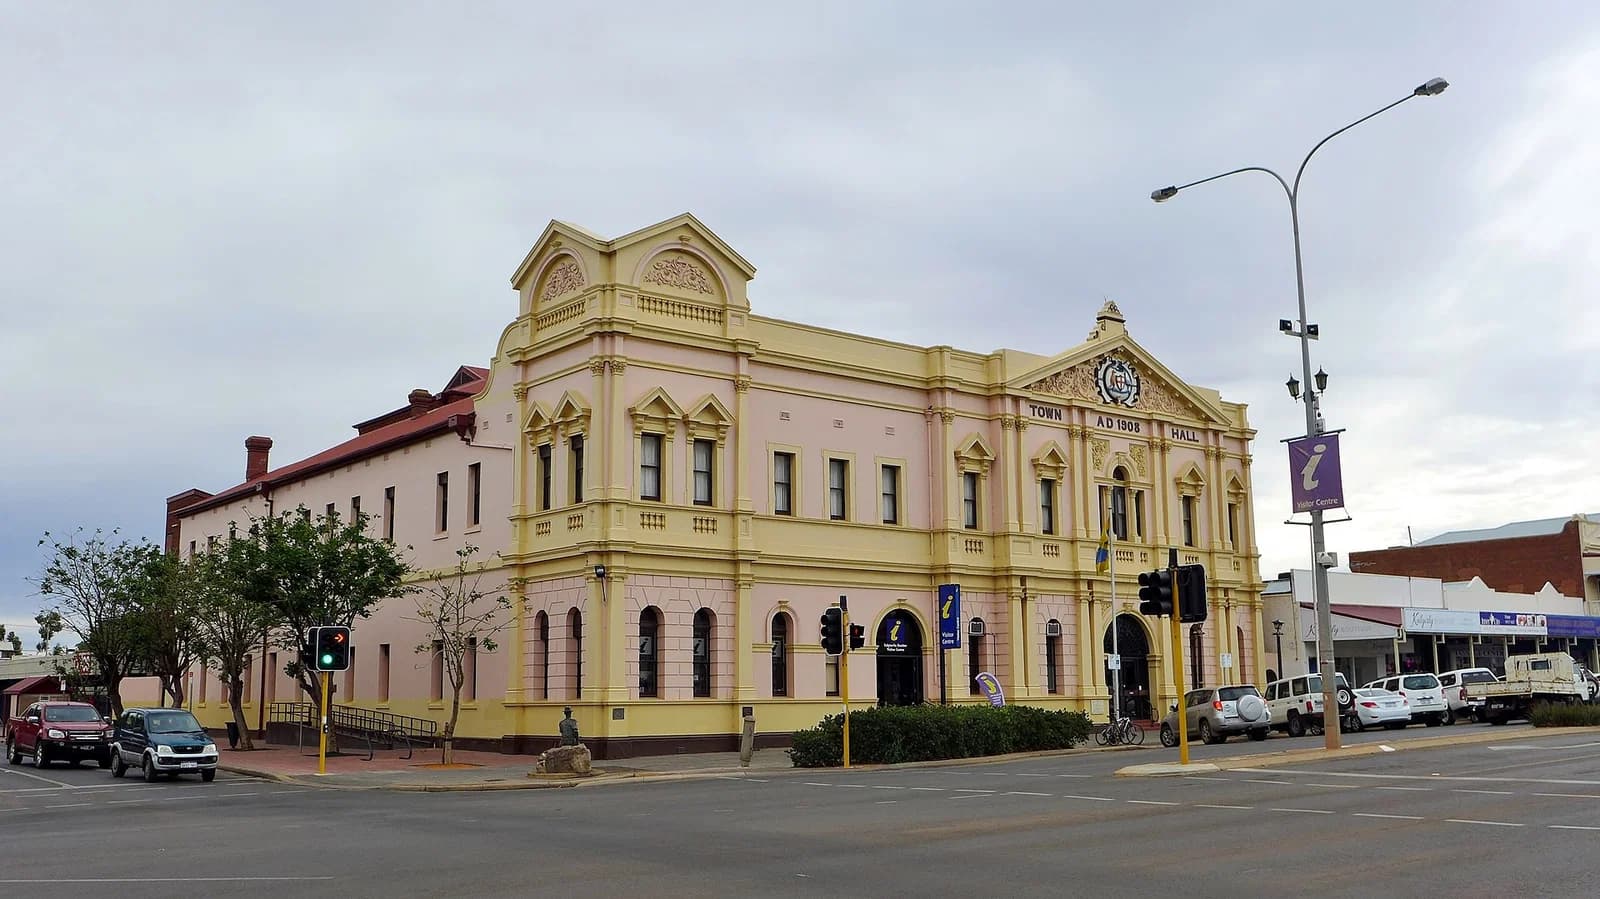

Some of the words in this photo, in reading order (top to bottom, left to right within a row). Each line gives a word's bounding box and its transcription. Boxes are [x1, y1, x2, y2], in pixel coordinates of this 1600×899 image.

[1029, 404, 1063, 421] TOWN
[1097, 415, 1114, 429] AD
[1117, 418, 1141, 433] 1908
[1171, 427, 1200, 443] HALL
[1315, 498, 1338, 506] Centre
